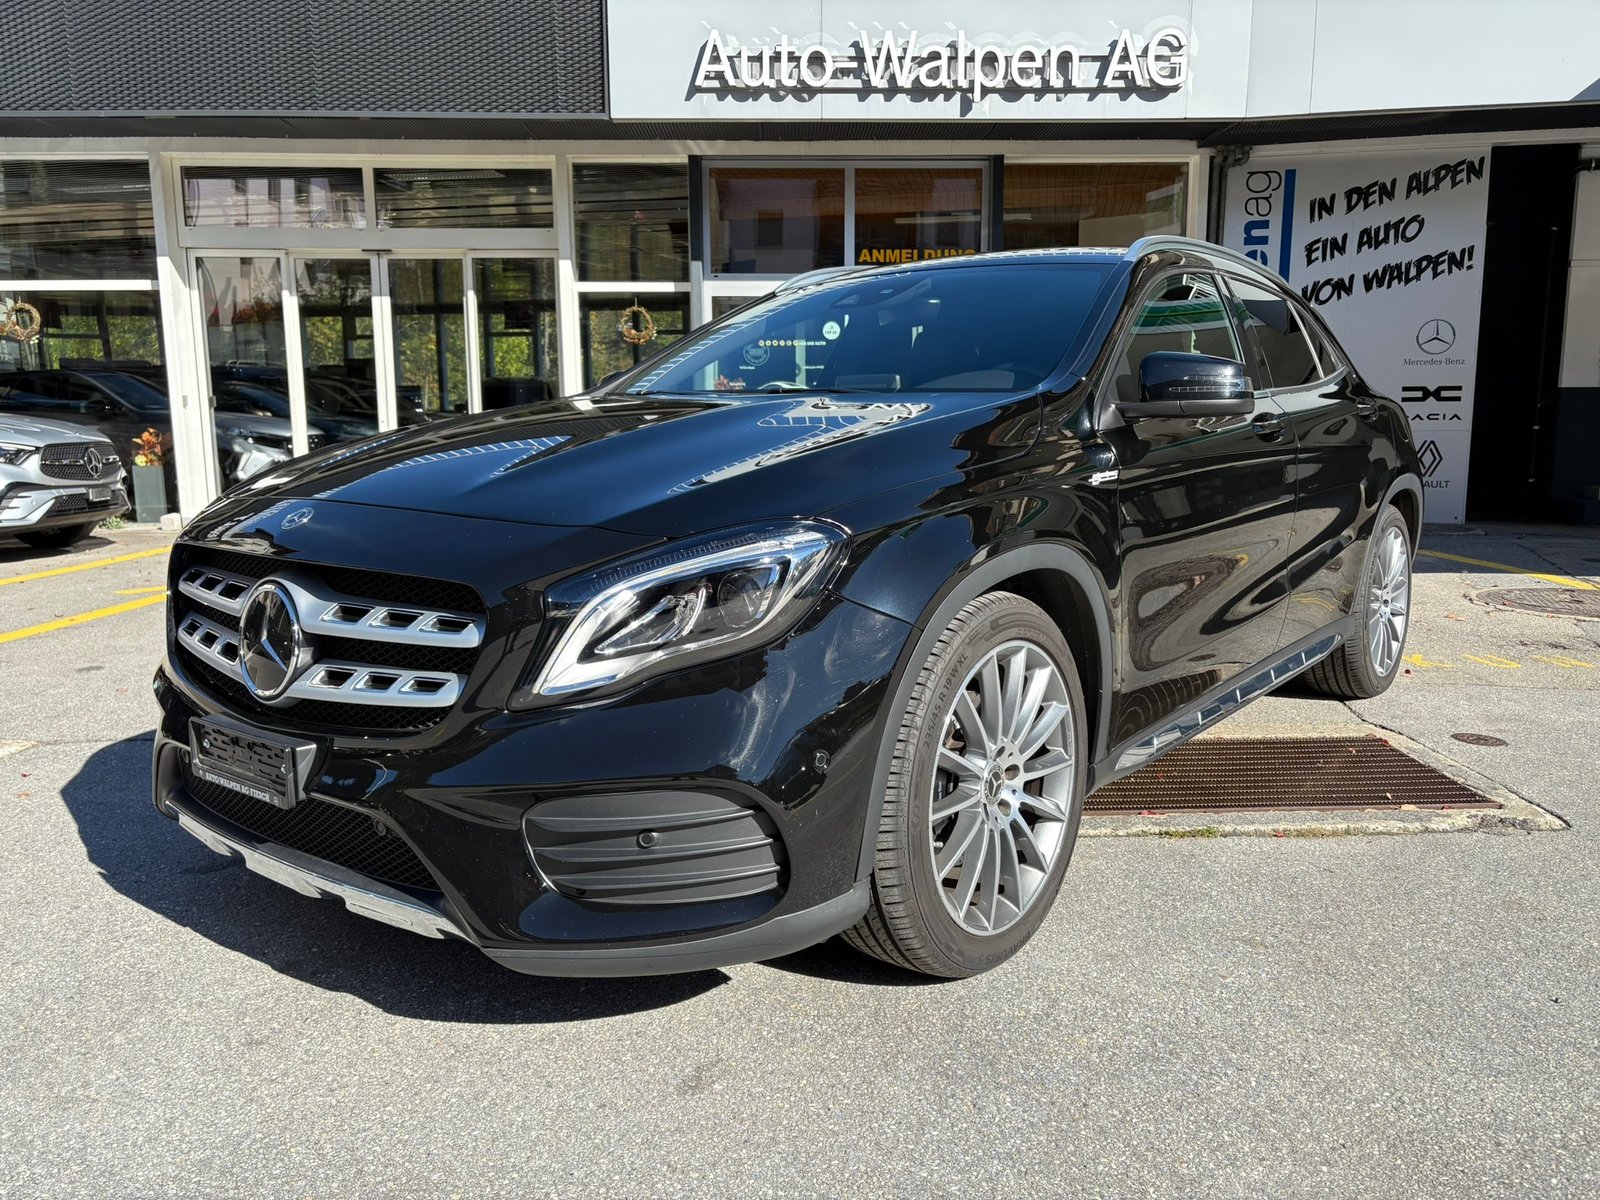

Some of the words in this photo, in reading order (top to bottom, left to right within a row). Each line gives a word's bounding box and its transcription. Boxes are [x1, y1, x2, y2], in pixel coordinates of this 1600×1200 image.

[695, 29, 1080, 103] Auto-Walpen
[1104, 27, 1189, 87] AG
[1309, 192, 1336, 224] IN
[1343, 177, 1397, 215] DEN
[1405, 156, 1485, 200] ALPEN
[1243, 170, 1282, 267] enag
[1304, 232, 1348, 267] EIN
[1356, 214, 1425, 255] AUTO
[858, 248, 976, 263] ANMELDU
[1301, 273, 1355, 306] VON
[1362, 244, 1475, 294] WALPEN!
[1403, 357, 1466, 366] Mercedes-Benz
[1407, 413, 1462, 421] ACIA
[1423, 480, 1451, 488] AULT
